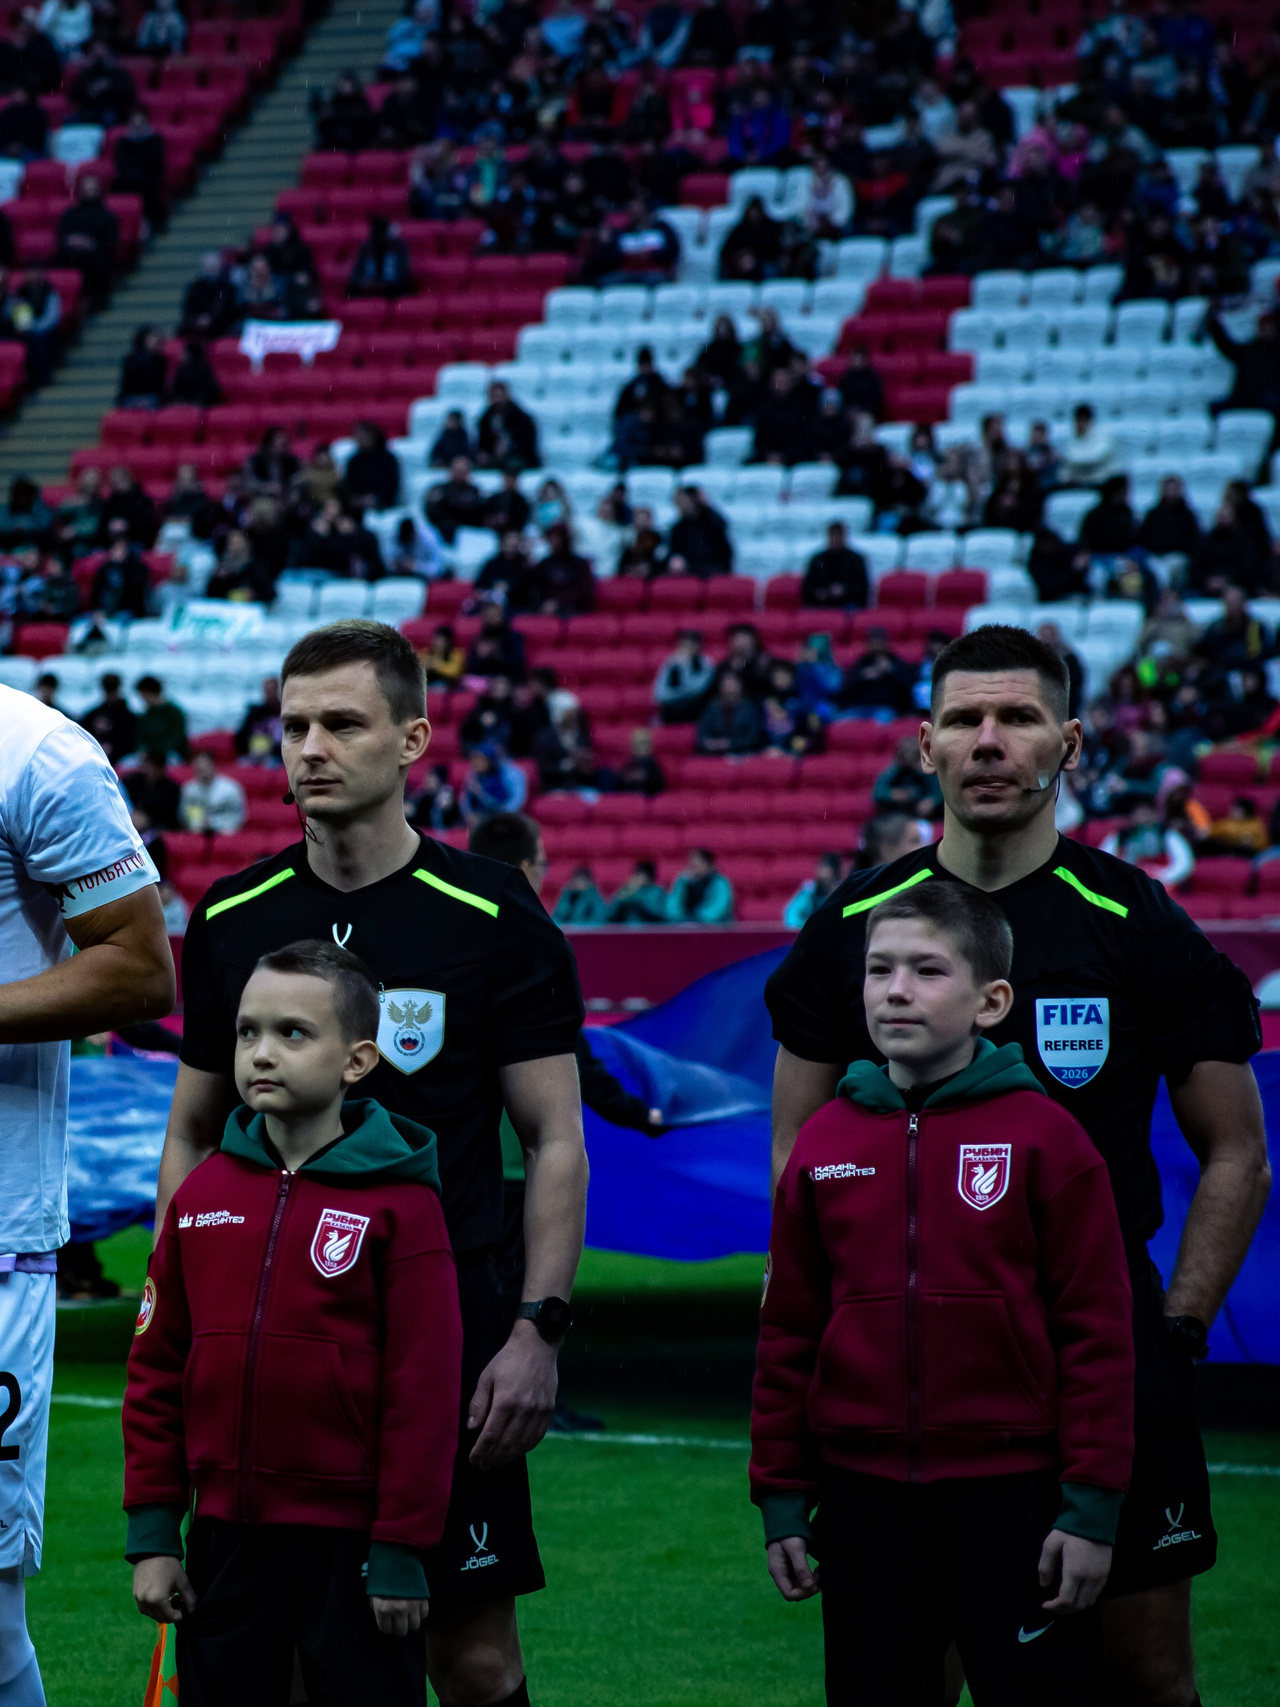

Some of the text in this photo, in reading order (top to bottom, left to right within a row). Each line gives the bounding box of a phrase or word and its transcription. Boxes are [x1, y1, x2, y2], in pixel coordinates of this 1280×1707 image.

[1043, 1004, 1104, 1026] FIFA
[1044, 1039, 1104, 1052] REFEREE
[1061, 1069, 1089, 1079] 2026
[963, 1147, 1009, 1157] РУБИН
[814, 1162, 857, 1174] КАЗАНЬ
[814, 1167, 876, 1181] ОРГСИНТЕЗ
[195, 1216, 245, 1228] ОРГСИНТЕЗ
[323, 1212, 367, 1229] РУБИН
[1152, 1530, 1202, 1550] JÖGEL
[460, 1554, 499, 1571] JÖGEL
